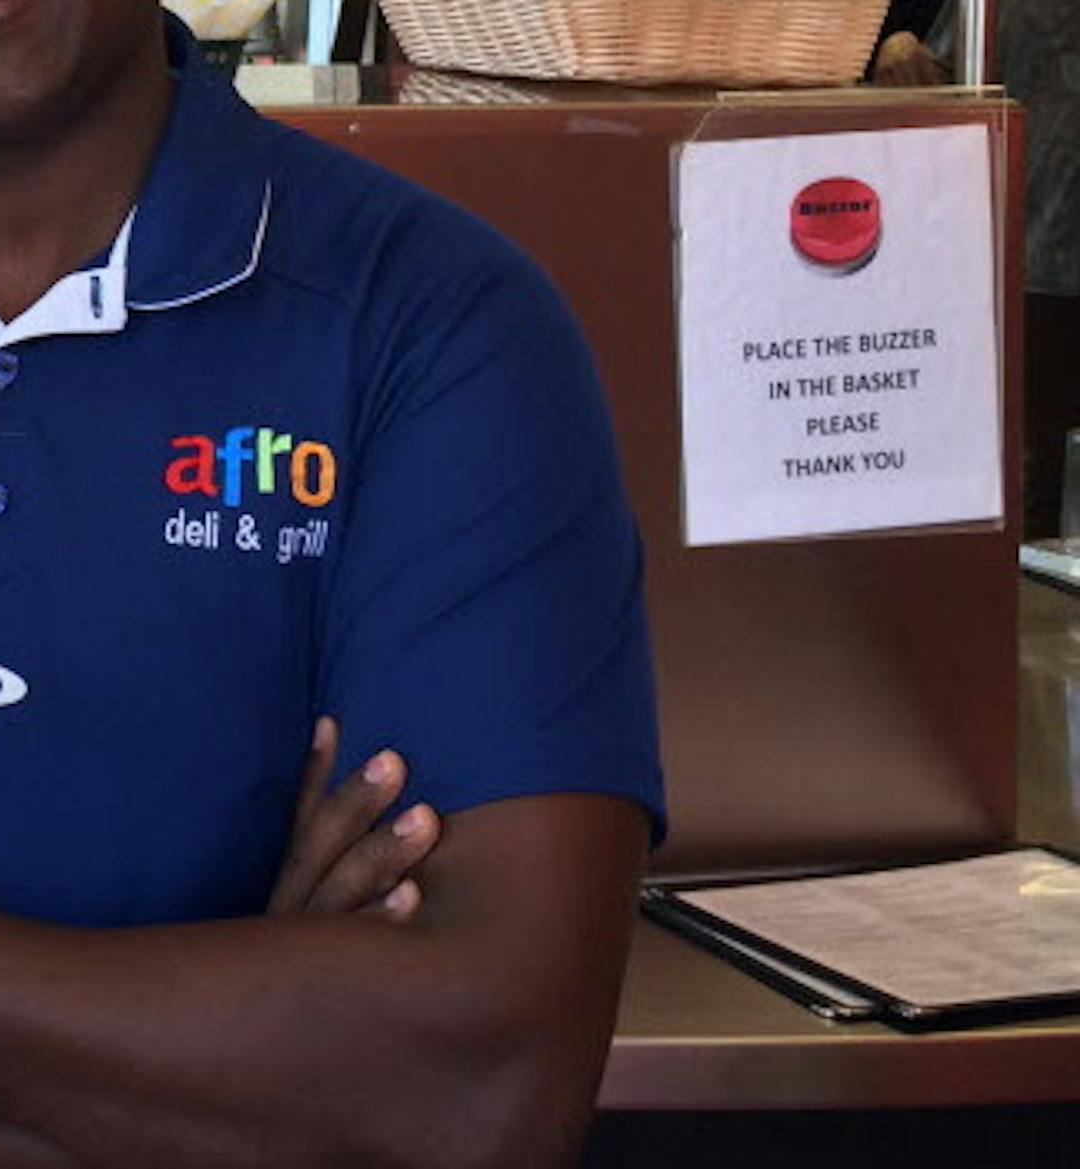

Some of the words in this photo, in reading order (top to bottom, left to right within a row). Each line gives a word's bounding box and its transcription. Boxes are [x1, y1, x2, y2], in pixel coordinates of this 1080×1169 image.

[743, 338, 807, 363] PLACE
[812, 335, 853, 357] THE
[858, 328, 938, 353] BUZZER
[769, 380, 791, 400] IN
[796, 375, 836, 398] THE
[843, 368, 921, 394] BASKET
[806, 411, 881, 437] PLEASE
[165, 426, 336, 508] afro
[783, 453, 857, 480] THANK
[860, 447, 906, 471] YOU
[164, 506, 219, 550] deli
[234, 513, 261, 551] &
[276, 519, 329, 564] grill
